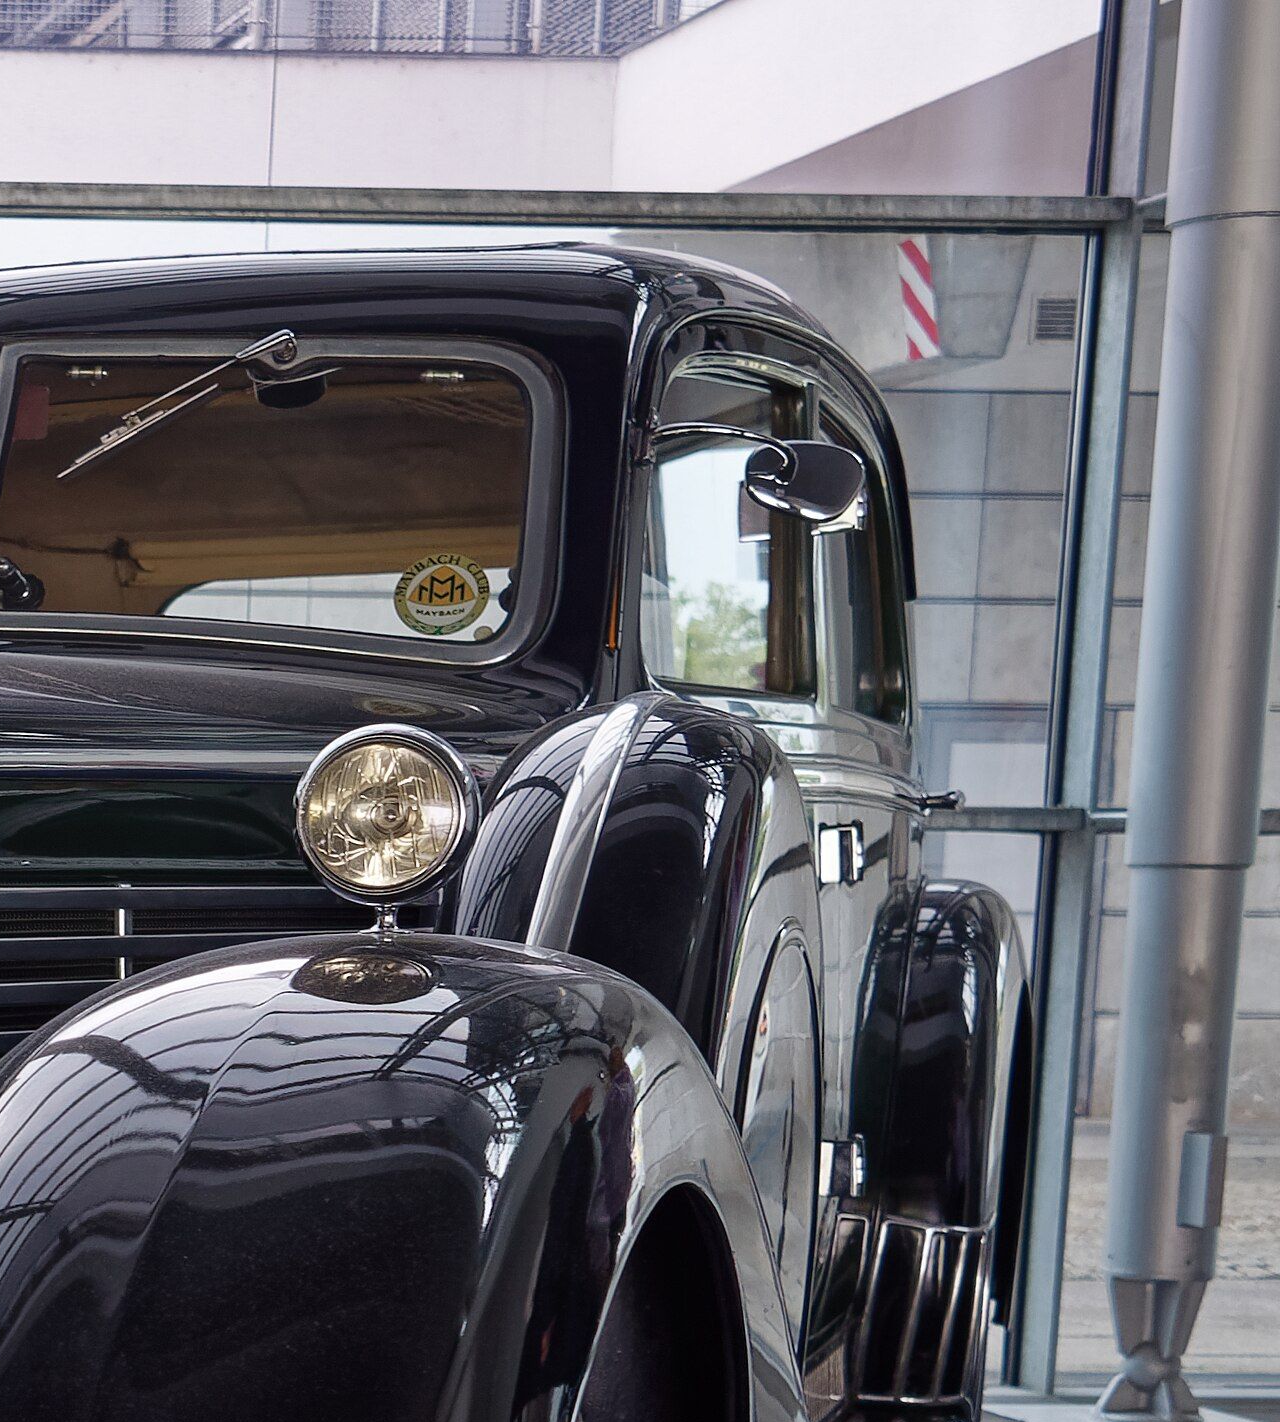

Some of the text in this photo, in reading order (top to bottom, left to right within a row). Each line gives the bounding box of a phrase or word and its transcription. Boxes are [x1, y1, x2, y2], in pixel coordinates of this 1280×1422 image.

[395, 554, 488, 596] MAYBACH CLUB
[415, 607, 466, 617] MAYBACH
